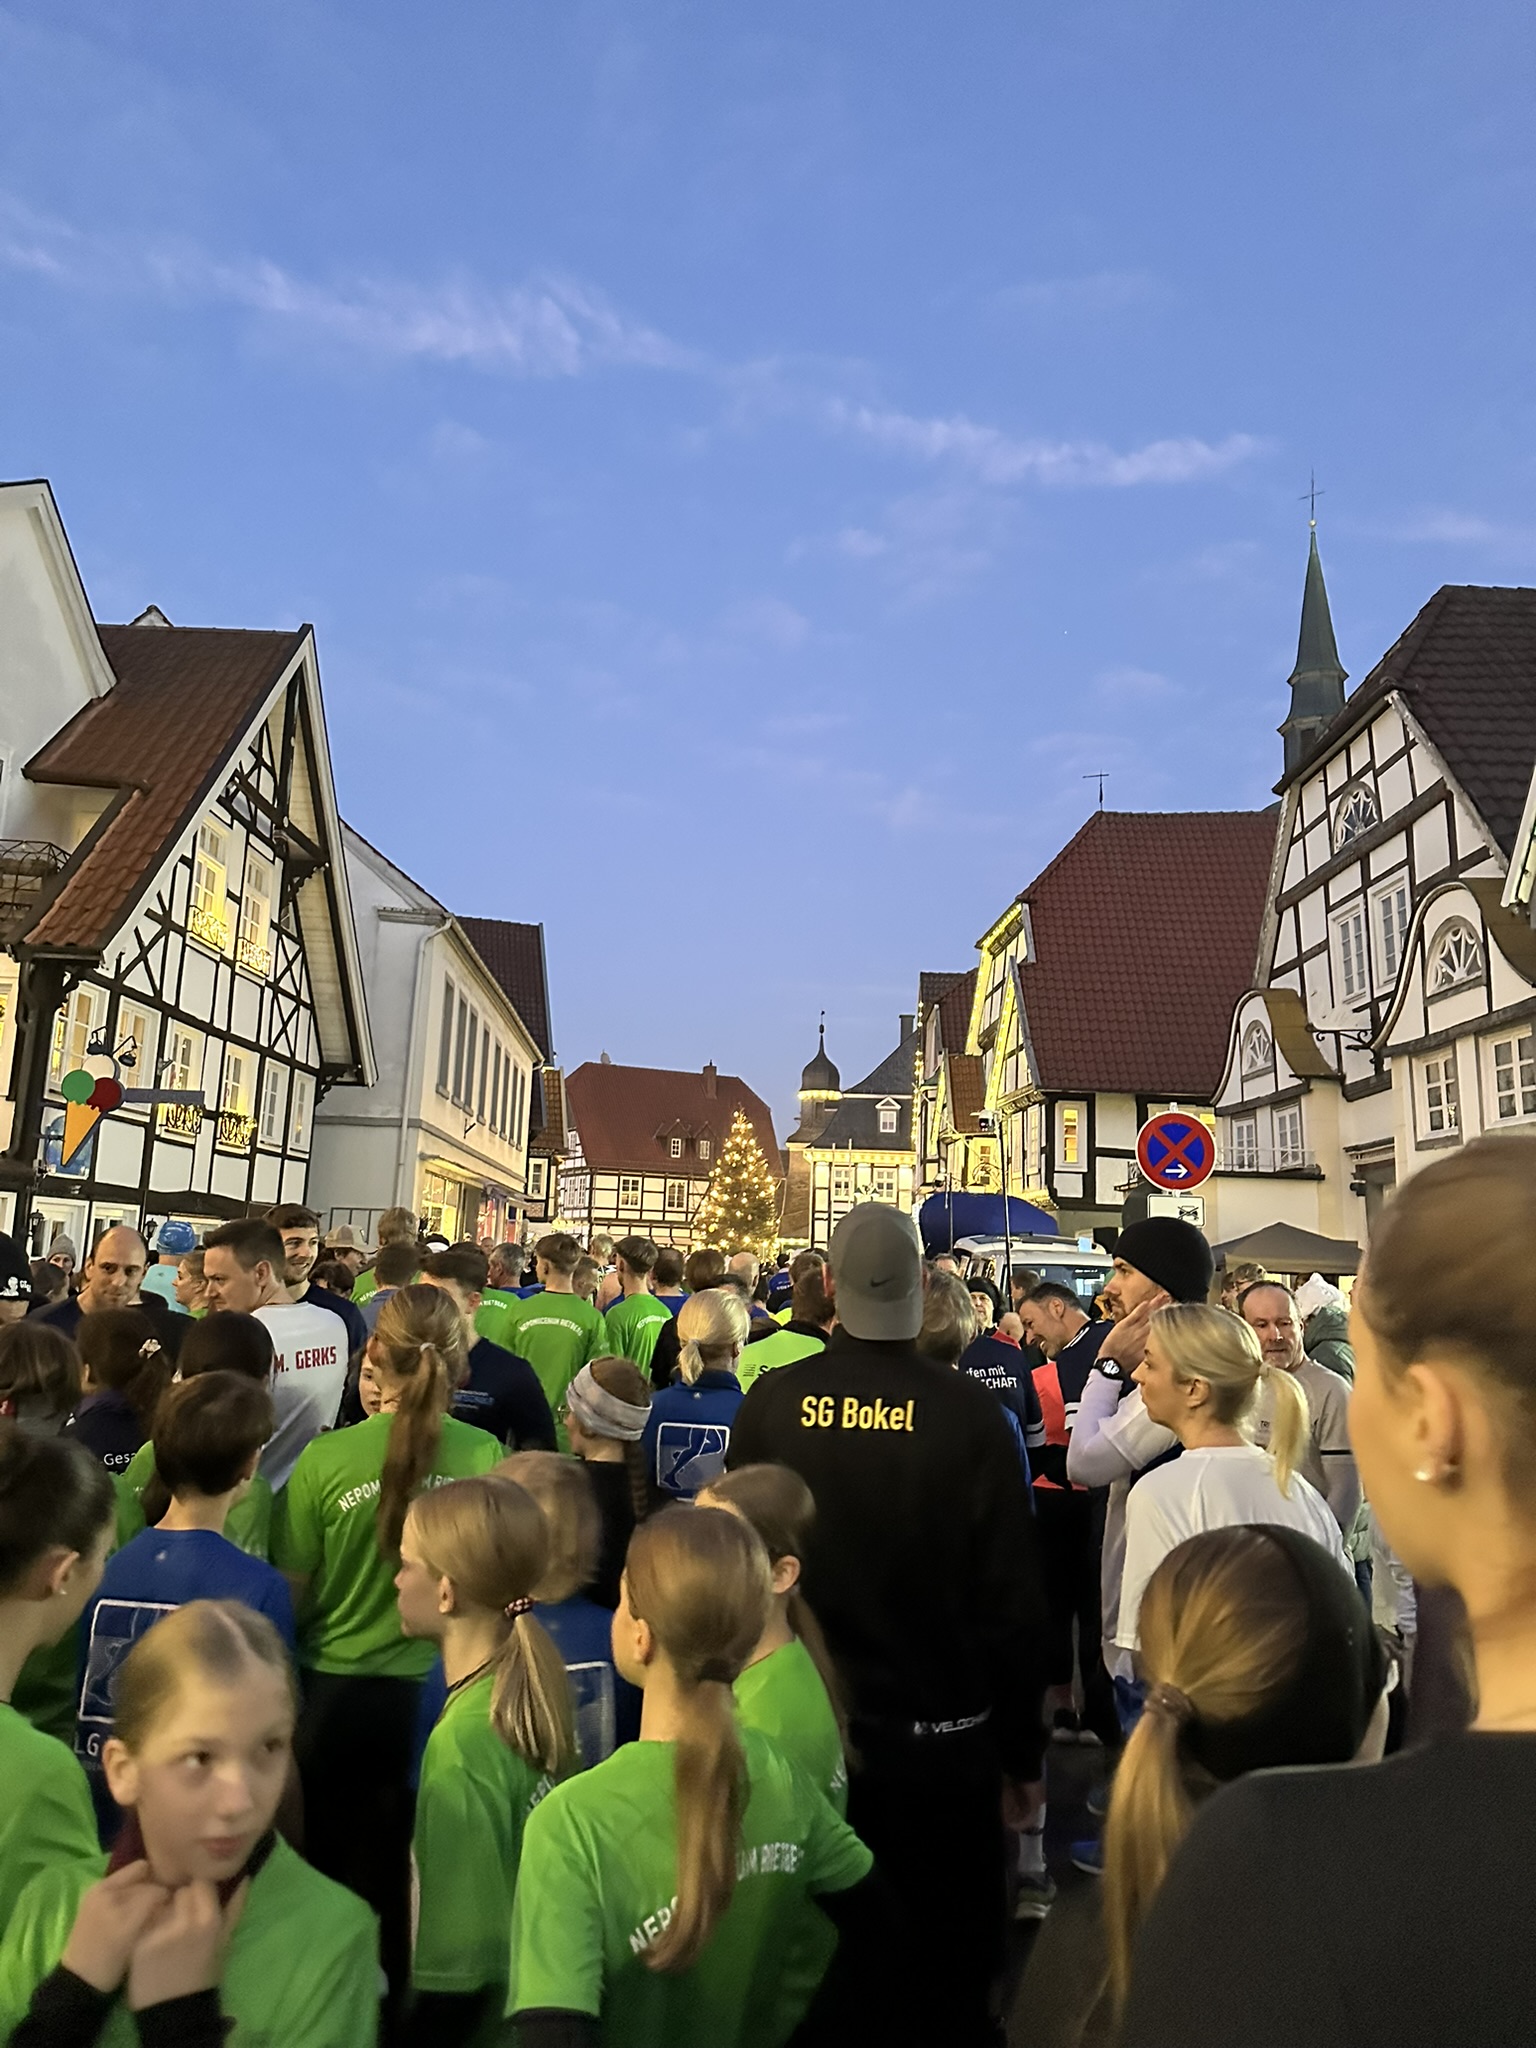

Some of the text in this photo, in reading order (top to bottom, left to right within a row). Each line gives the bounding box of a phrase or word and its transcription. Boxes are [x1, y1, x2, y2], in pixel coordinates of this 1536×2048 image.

[295, 1345, 337, 1370] GERKS
[988, 1364, 1006, 1377] mit
[801, 1395, 915, 1432] SG Bokel
